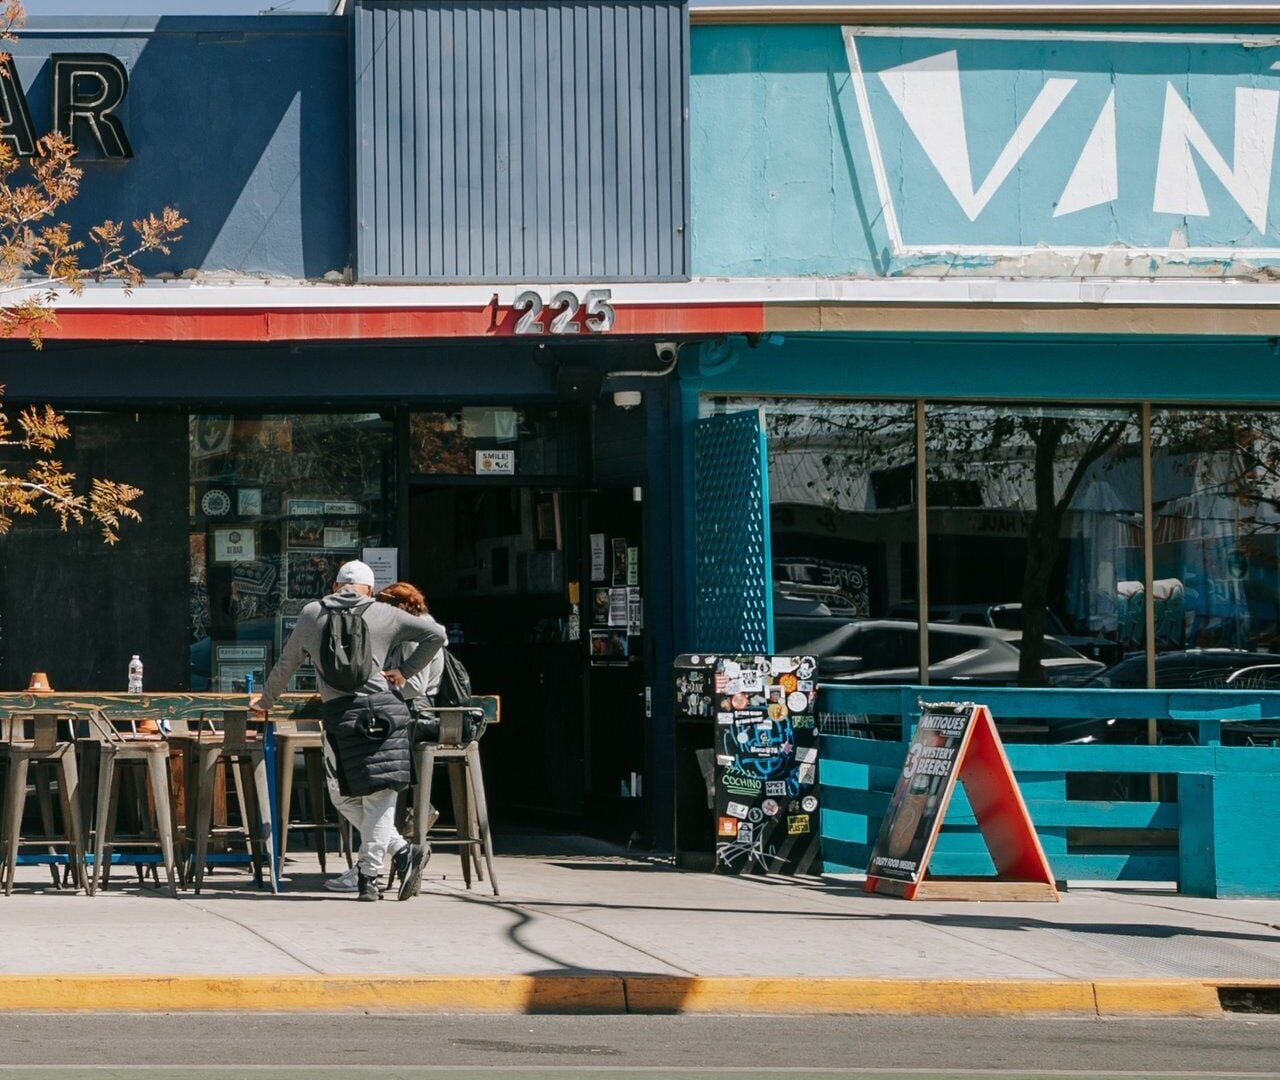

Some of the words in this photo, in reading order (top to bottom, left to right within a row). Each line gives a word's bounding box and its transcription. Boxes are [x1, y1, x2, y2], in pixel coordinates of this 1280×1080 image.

[878, 49, 1280, 235] VIN
[484, 288, 617, 336] 1225
[920, 715, 967, 731] ANTIQUES
[921, 748, 955, 760] MYSTERY
[916, 758, 952, 777] BEERS!
[722, 774, 761, 789] COCHINO
